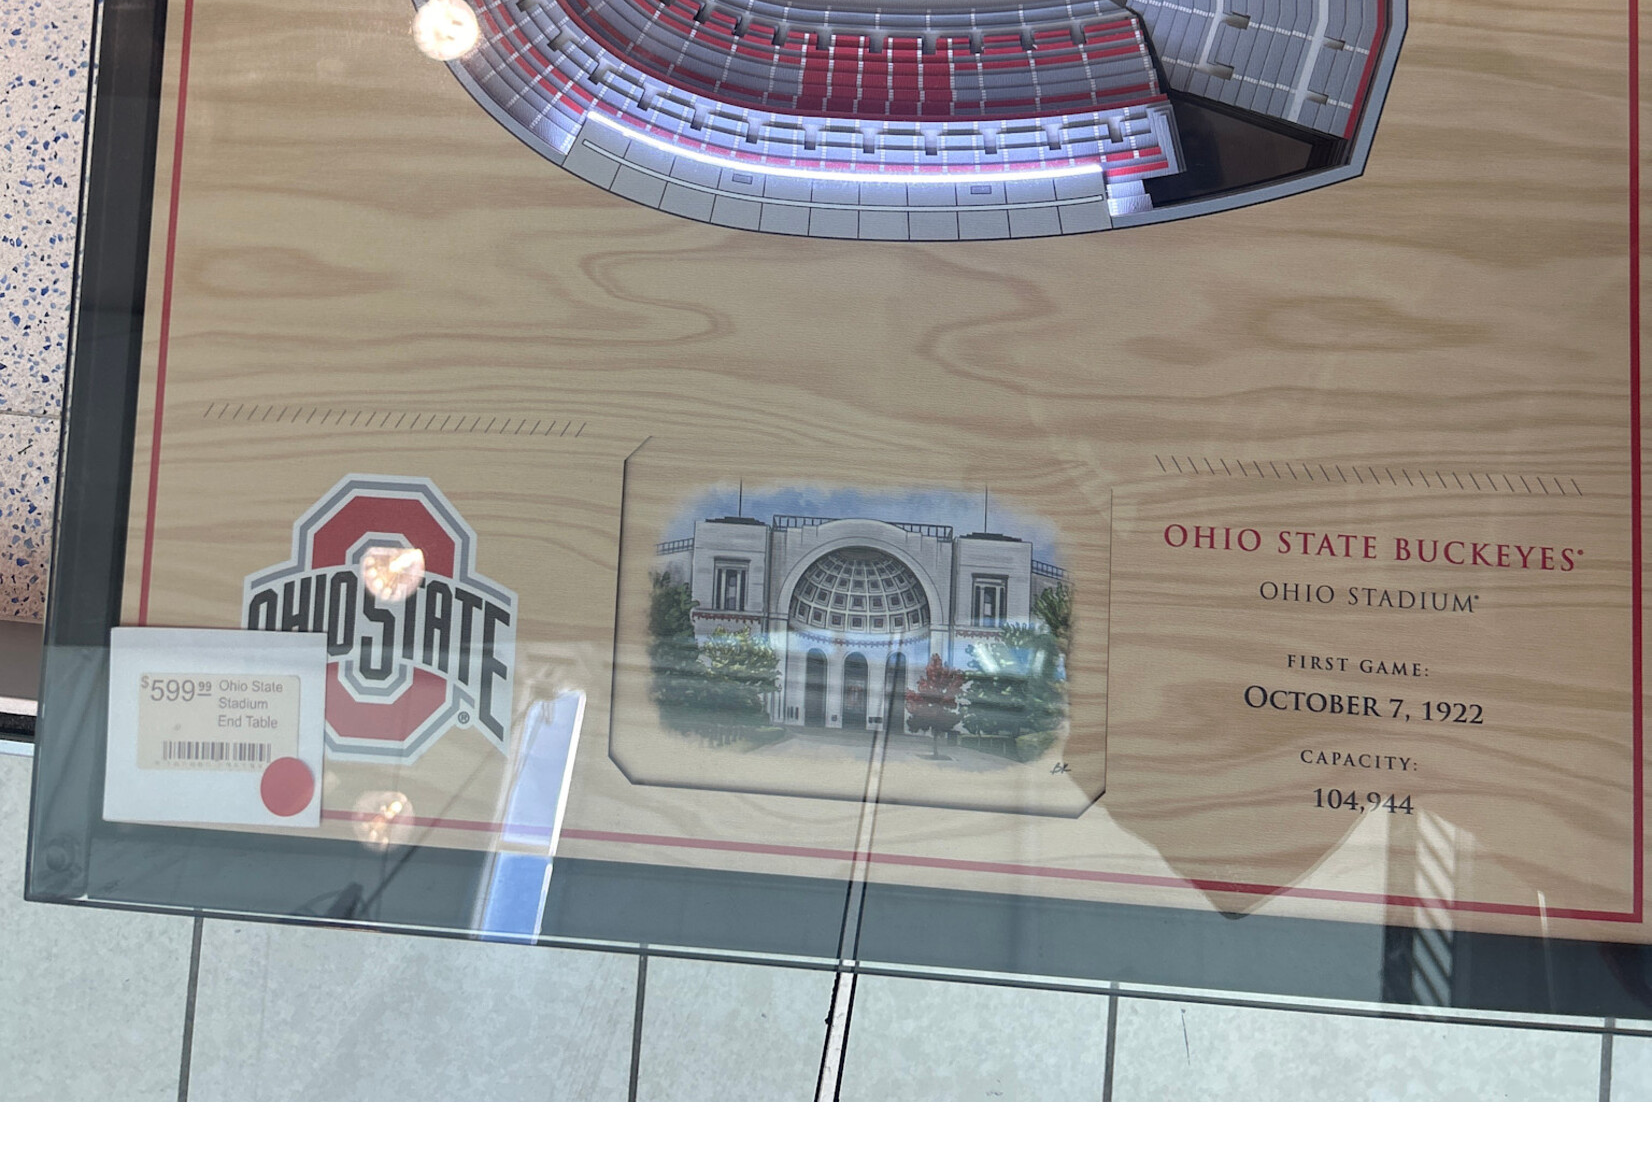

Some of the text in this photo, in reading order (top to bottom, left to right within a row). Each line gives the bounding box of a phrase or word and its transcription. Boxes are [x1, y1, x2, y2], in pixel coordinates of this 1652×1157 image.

[1163, 523, 1262, 552] OHIO
[1277, 530, 1377, 559] STATE
[1259, 581, 1335, 604] OHIO
[1287, 654, 1430, 677] FIRST GAME:
[219, 679, 283, 693] Ohio State
[218, 696, 269, 710] Stadium
[1243, 685, 1484, 725] OCTOBER 7, 1922
[218, 715, 278, 729] End Table
[1300, 749, 1418, 772] CAPACITY:
[1313, 788, 1414, 815] 104,944
